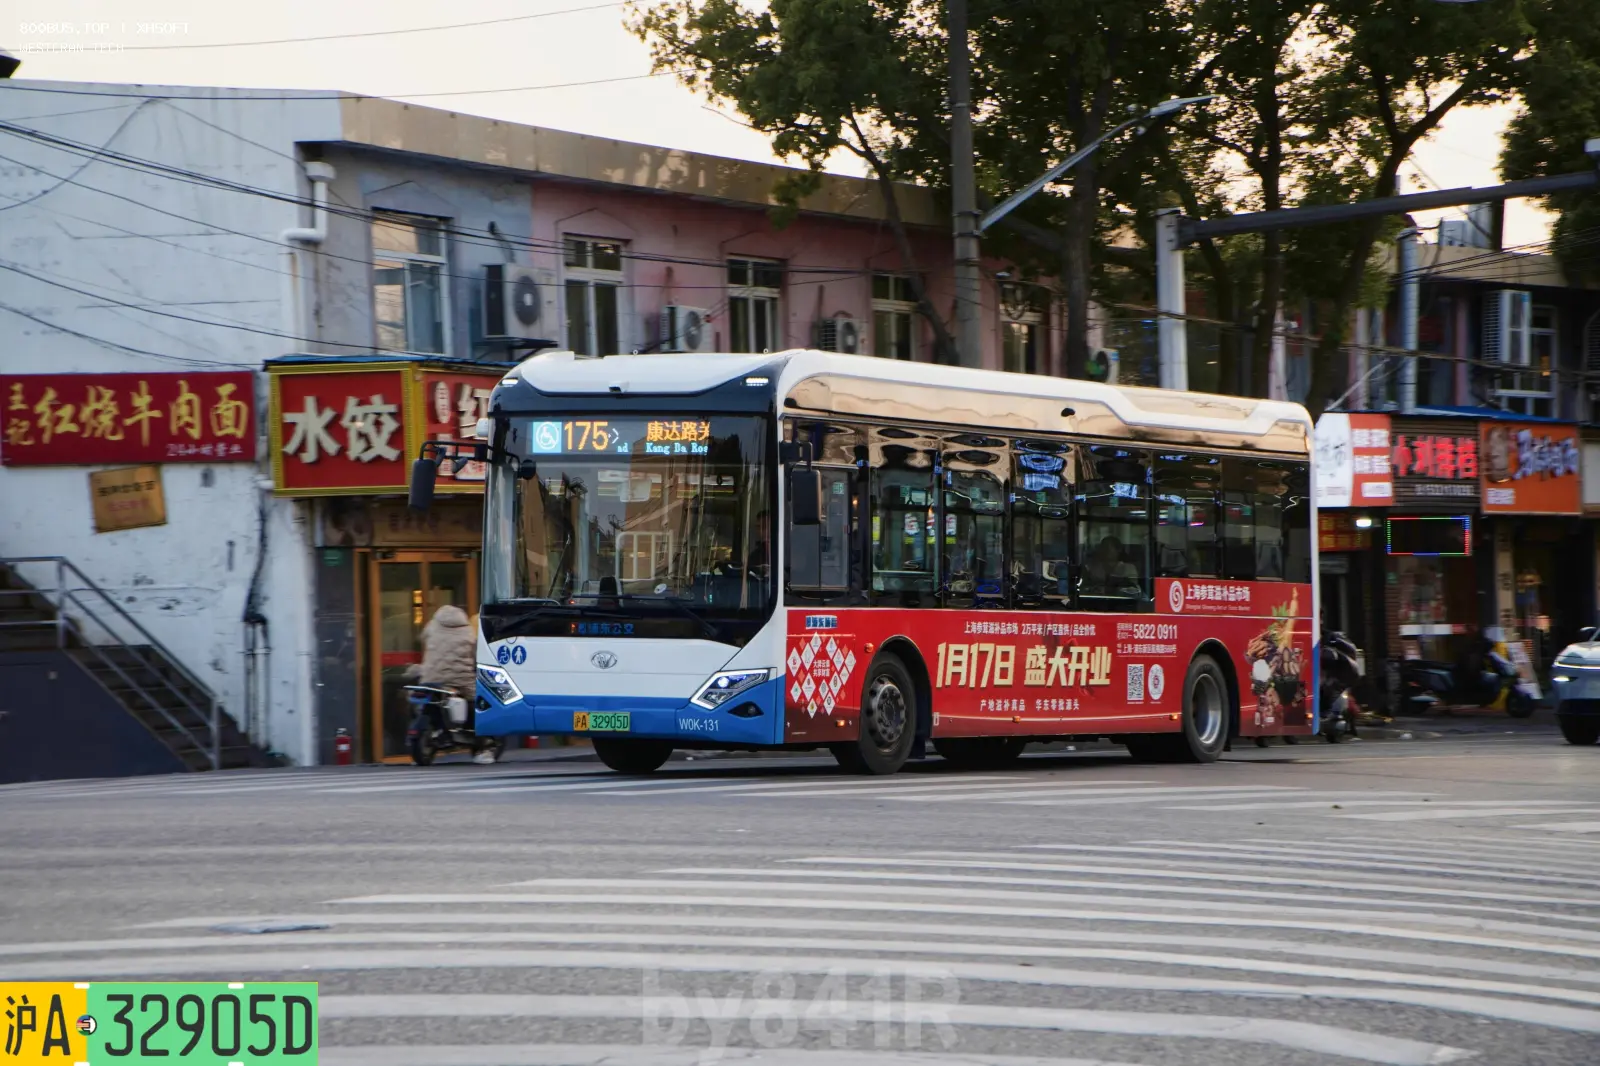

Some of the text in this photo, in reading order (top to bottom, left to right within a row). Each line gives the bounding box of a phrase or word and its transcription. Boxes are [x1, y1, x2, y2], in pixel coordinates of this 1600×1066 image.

[34, 380, 248, 447] 红烧牛肉面
[282, 394, 401, 464] 水饺
[564, 421, 609, 450] 175
[645, 443, 671, 455] Kang
[674, 443, 687, 453] Da
[1133, 623, 1156, 640] 5822
[1157, 624, 1178, 640] 0911
[936, 642, 1112, 688] 1月17日 盛大开业
